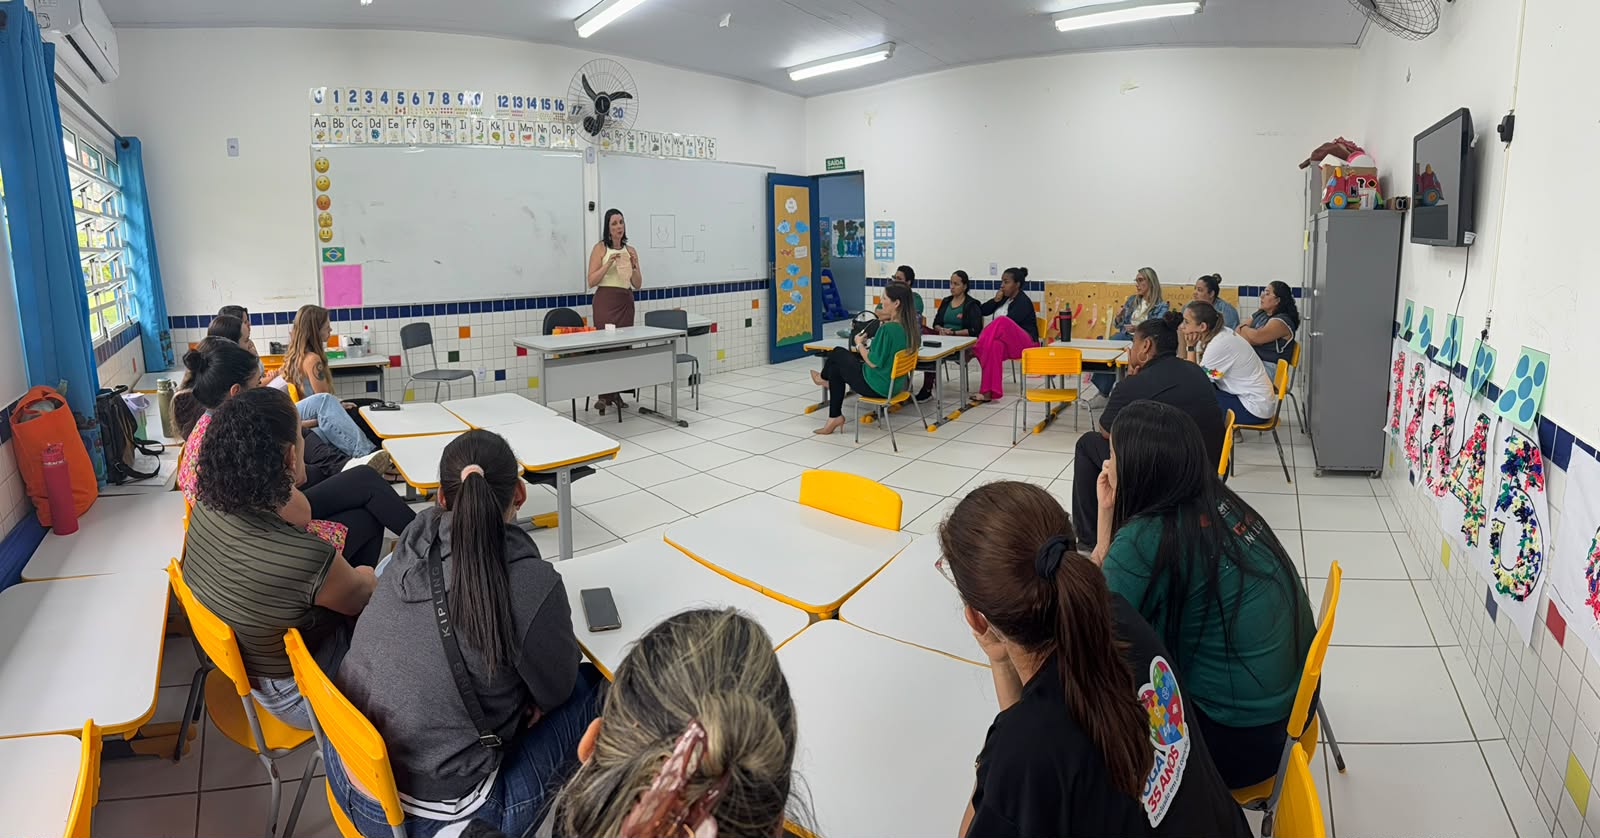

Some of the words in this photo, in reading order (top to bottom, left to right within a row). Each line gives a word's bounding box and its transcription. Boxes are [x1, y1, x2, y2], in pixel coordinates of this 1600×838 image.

[333, 89, 339, 104] 1
[349, 89, 357, 104] 2
[364, 90, 373, 104] 3
[380, 91, 389, 104] 4
[397, 91, 405, 105] 5
[412, 92, 420, 105] 6
[427, 91, 435, 105] 7
[442, 92, 450, 105] 8
[457, 92, 465, 105] 9
[497, 95, 509, 108] 12
[512, 95, 523, 109] 13
[526, 96, 538, 110] 14
[540, 98, 551, 111] 15
[554, 99, 565, 112] 16
[571, 104, 582, 116] 17
[612, 106, 624, 119] 20
[314, 118, 327, 128] Aa
[332, 118, 345, 129] Bb
[351, 118, 363, 129] Cc
[369, 118, 381, 129] Dd
[388, 118, 399, 129] Ee
[406, 118, 417, 129] Ff
[423, 118, 435, 132] Gg
[440, 119, 452, 129] Hh
[459, 119, 467, 130] Ii
[475, 120, 484, 133] Jj
[490, 121, 500, 131] Kk
[507, 121, 516, 132] Ll
[520, 122, 534, 133] Mm
[537, 123, 548, 134] Nn
[551, 125, 562, 135] Oo
[566, 125, 575, 137] Pp
[640, 132, 647, 142] Tt
[1450, 412, 1490, 548] 4
[1489, 428, 1544, 602] 5
[432, 566, 451, 638] KIPLING
[1147, 785, 1162, 813] 35
[1159, 744, 1179, 792] ANOS
